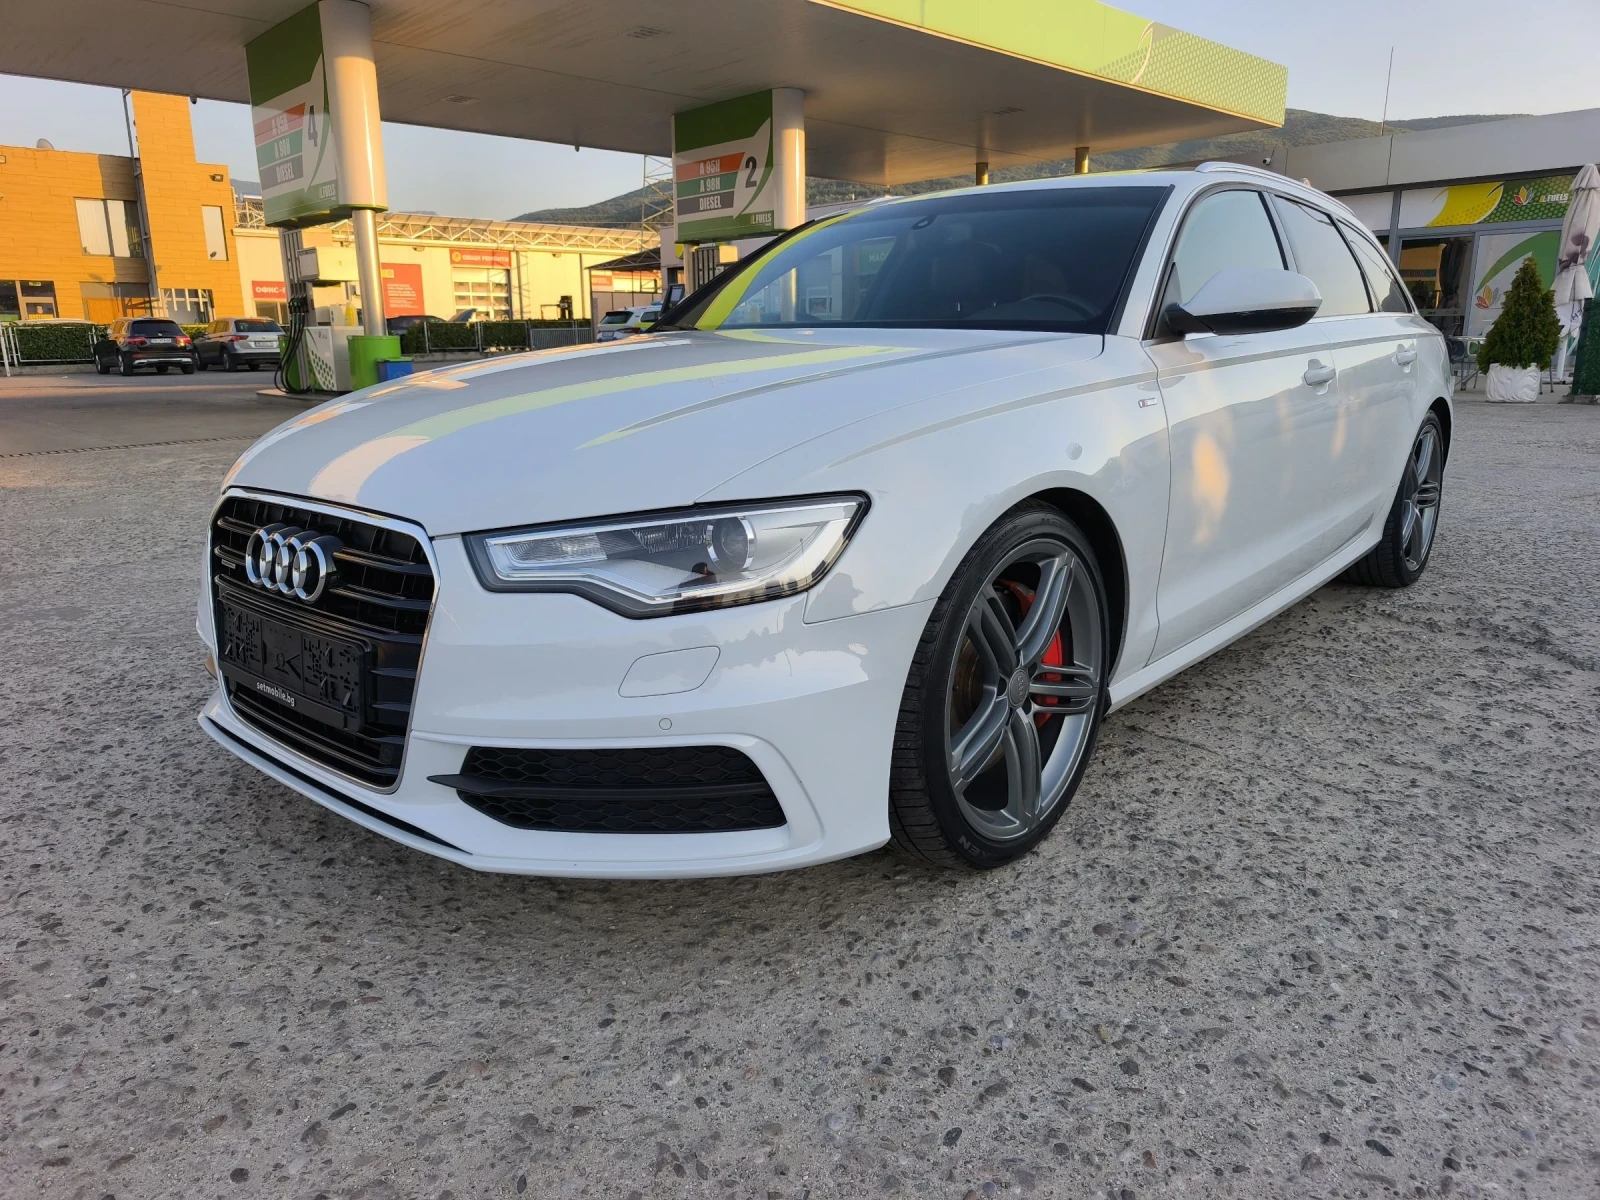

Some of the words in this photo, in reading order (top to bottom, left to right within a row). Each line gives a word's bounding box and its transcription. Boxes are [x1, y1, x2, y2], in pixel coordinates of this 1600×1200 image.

[308, 105, 318, 147] 4
[276, 162, 295, 183] DIESEL
[700, 162, 705, 175] A
[706, 159, 720, 174] 95H
[745, 156, 757, 188] 2
[700, 179, 705, 193] A
[706, 177, 720, 191] 98H
[700, 195, 722, 211] DIESEL
[1547, 193, 1569, 202] FUELS
[756, 212, 772, 224] FUELS
[256, 682, 295, 707] setmobile.bg
